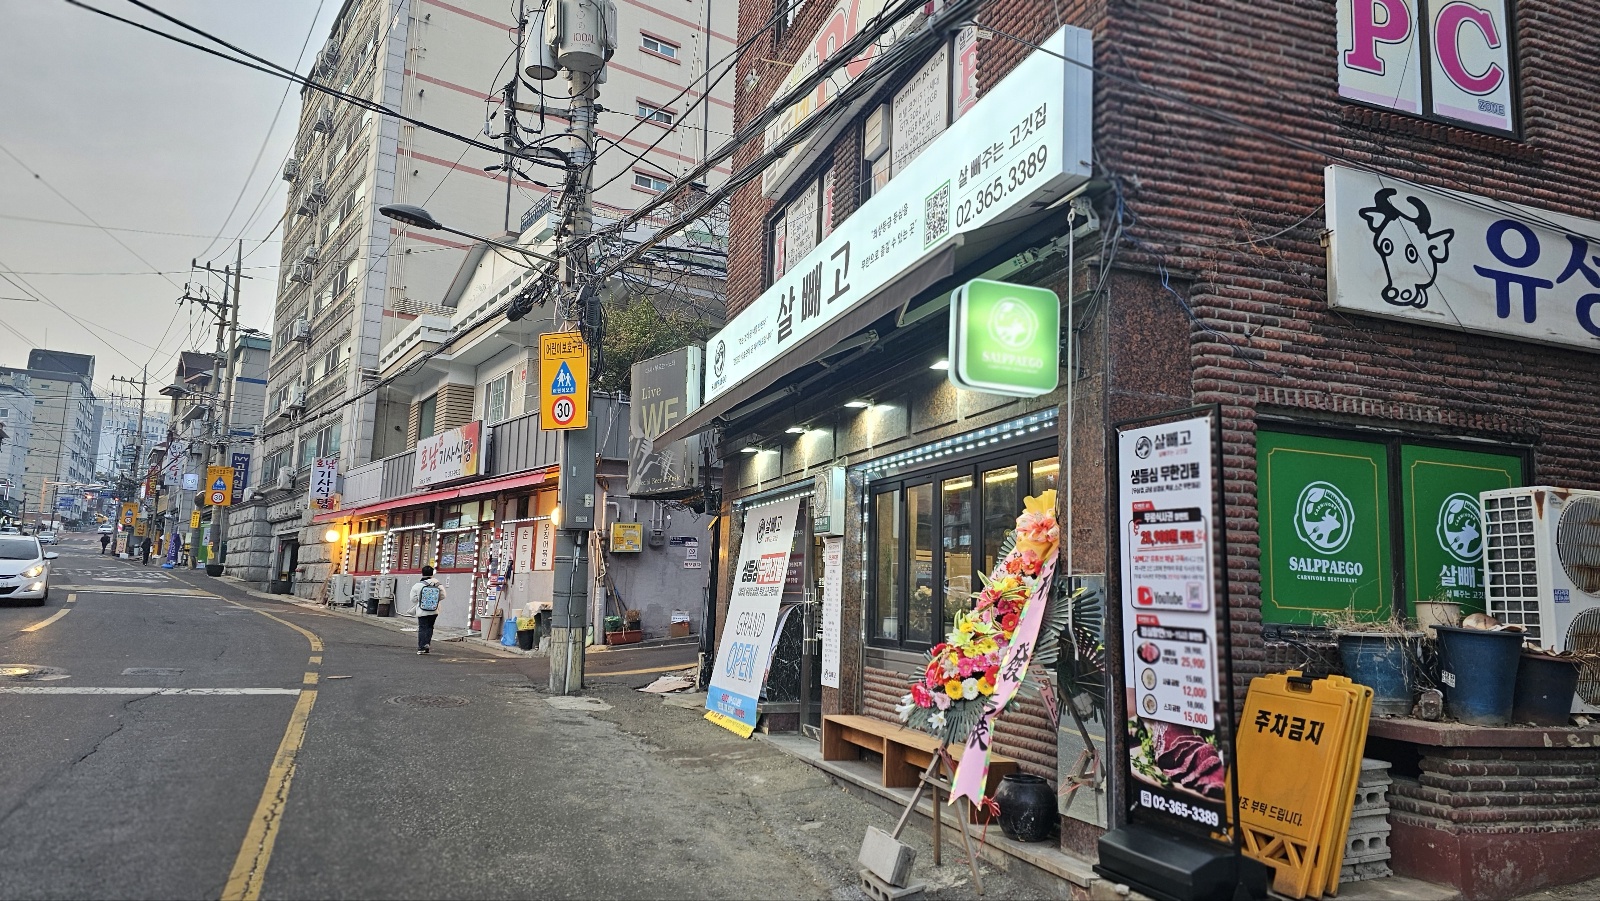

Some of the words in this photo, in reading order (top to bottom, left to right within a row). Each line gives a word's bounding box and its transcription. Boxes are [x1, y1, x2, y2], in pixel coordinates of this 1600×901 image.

[930, 51, 945, 72] club
[1478, 99, 1505, 116] ZONE
[958, 165, 969, 190] 살
[970, 141, 1005, 179] 빼주는
[1009, 102, 1047, 151] 고깃집
[956, 144, 1048, 228] 02.365.3389
[776, 240, 851, 345] 살빼고
[641, 386, 662, 401] Live
[557, 402, 571, 418] 30
[1154, 430, 1192, 451] 살빼고
[316, 458, 338, 470] 호남
[420, 443, 439, 472] 호남
[439, 437, 474, 465] 기사식당
[1131, 466, 1158, 485] 생등심
[1160, 461, 1200, 481] 무한리필
[316, 470, 334, 509] 기사식당
[1314, 502, 1337, 516] CARNIVORE
[520, 529, 528, 570] 순두부
[742, 559, 760, 583] 생등심
[1289, 556, 1364, 577] SALPPAEGO
[1296, 574, 1326, 582] CARNIVORE
[1327, 576, 1358, 584] RESTAURANT
[1153, 591, 1184, 606] YouTube
[1473, 590, 1487, 600] 고깃
[735, 611, 766, 638] GRAND
[726, 641, 760, 683] OPEN
[1181, 655, 1206, 670] 25,900
[1182, 685, 1207, 699] 12,000
[1183, 710, 1208, 725] 15,000
[1254, 709, 1326, 746] 주차금지
[1152, 794, 1219, 828] 02-365-3389
[1238, 796, 1248, 810] 조
[1250, 800, 1268, 815] 부탁
[1268, 805, 1303, 827] 드립니다.
